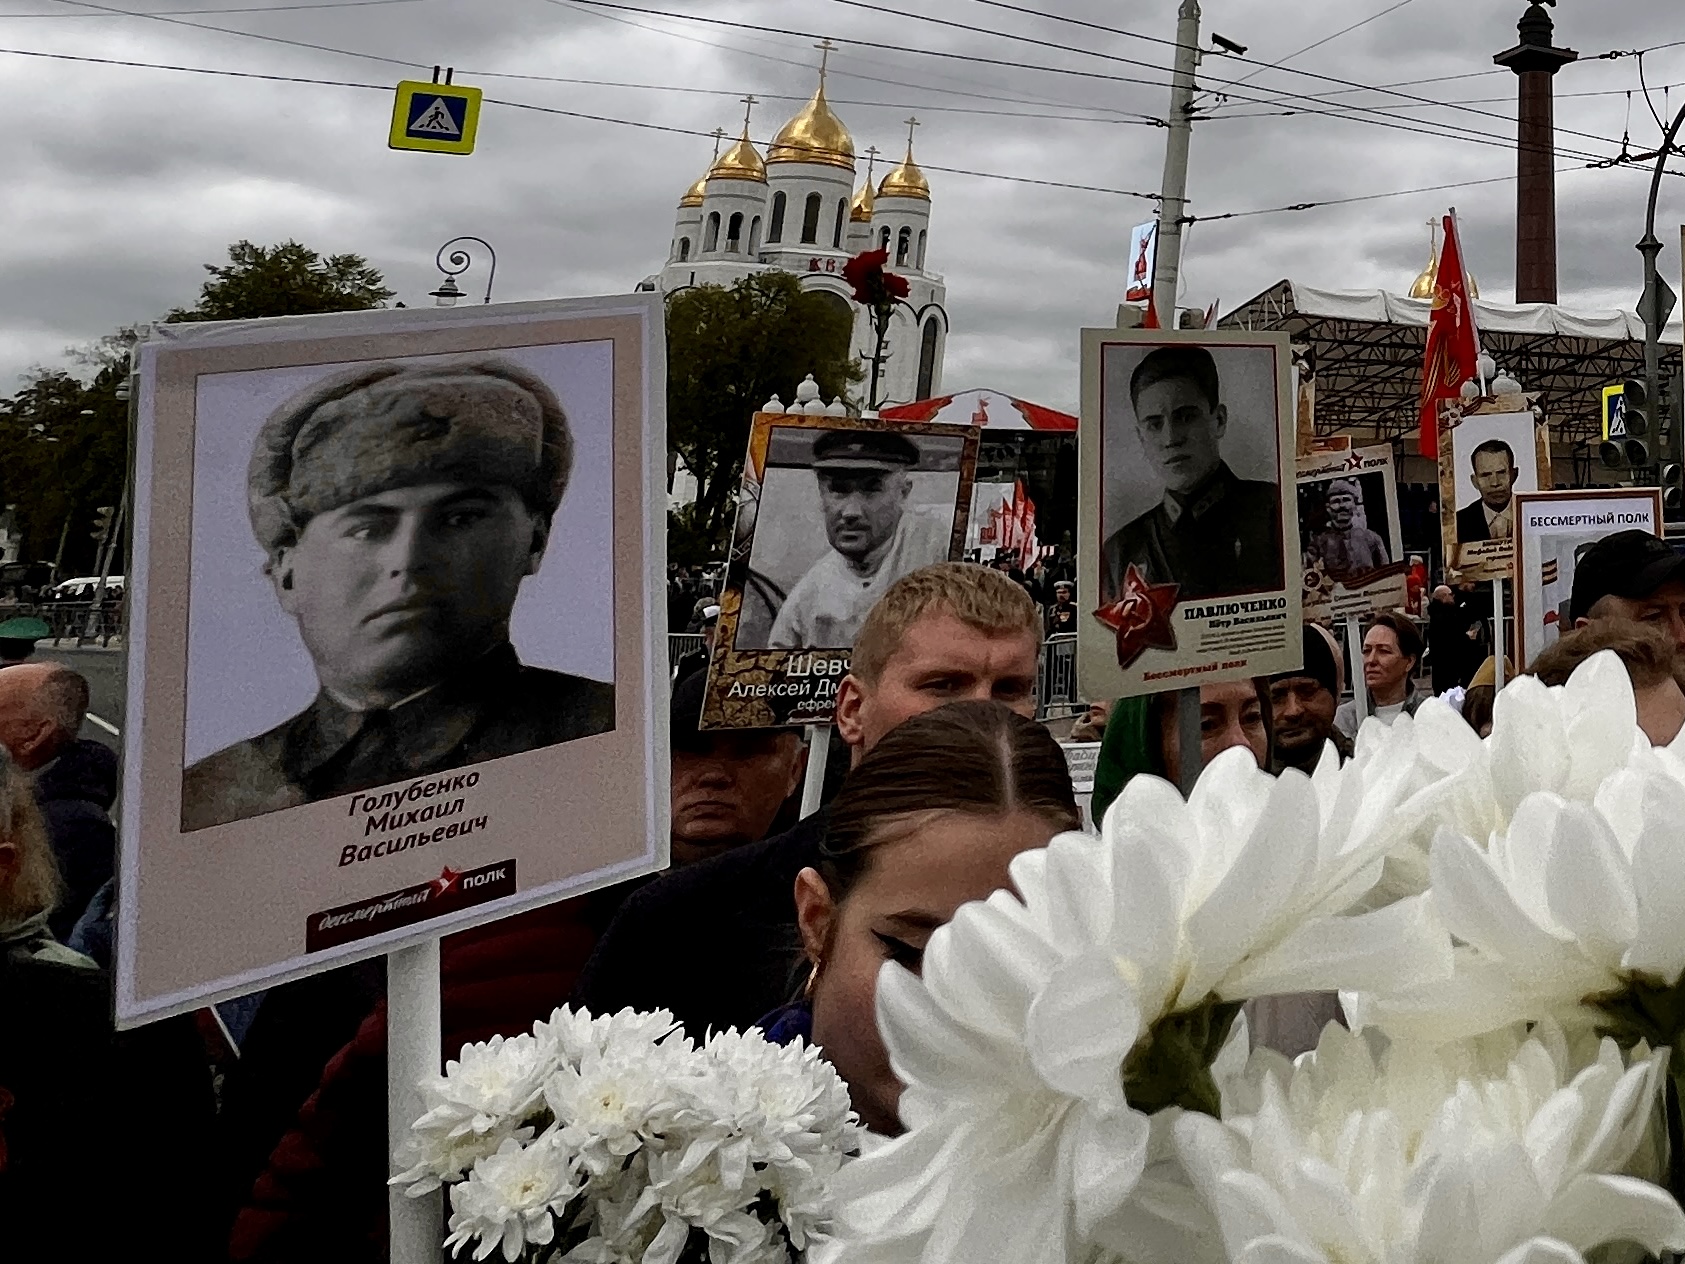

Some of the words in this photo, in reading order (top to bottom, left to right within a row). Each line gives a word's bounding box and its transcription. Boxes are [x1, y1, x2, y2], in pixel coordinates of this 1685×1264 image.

[1530, 512, 1615, 528] БЕССМЕРТНЫЙ
[1617, 512, 1650, 525] ПОЛК
[1184, 597, 1287, 620] ПАВЛЮЧЕНКО
[727, 678, 811, 698] Алексей
[348, 771, 481, 817] Голубенко
[364, 798, 465, 837] Михаил
[338, 815, 489, 867] Васильевич
